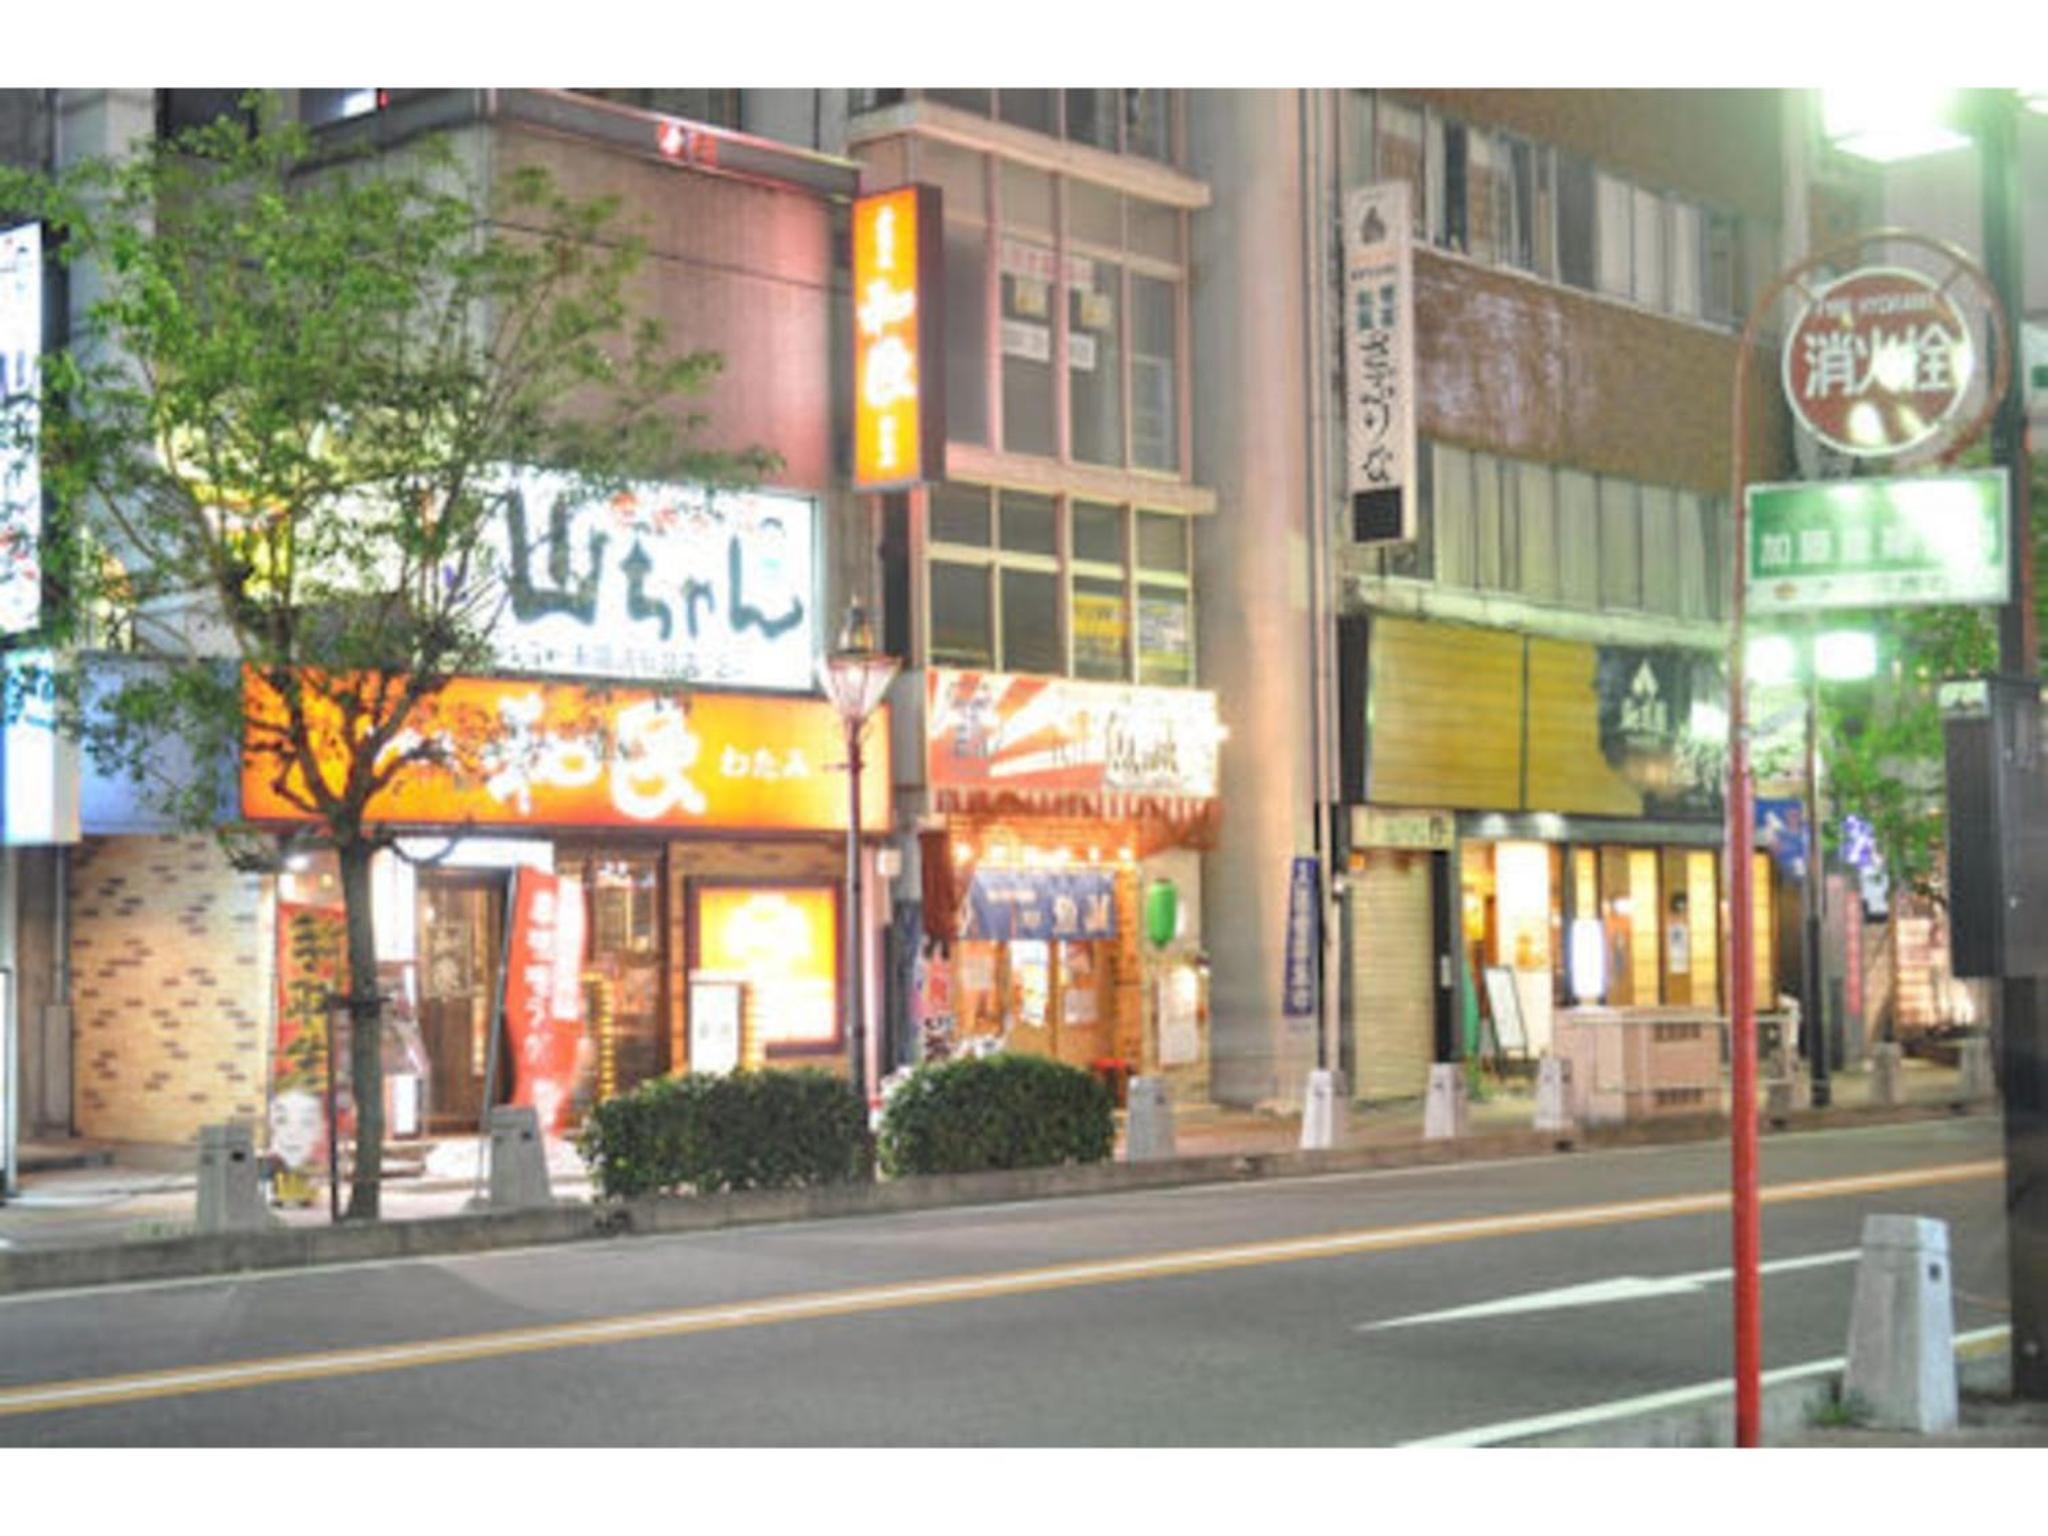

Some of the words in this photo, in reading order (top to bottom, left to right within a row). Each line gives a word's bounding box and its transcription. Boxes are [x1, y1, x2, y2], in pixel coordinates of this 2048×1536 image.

[1803, 323, 1953, 399] 消火栓
[506, 486, 804, 640] 山ちゃん
[720, 744, 808, 781] わたみ
